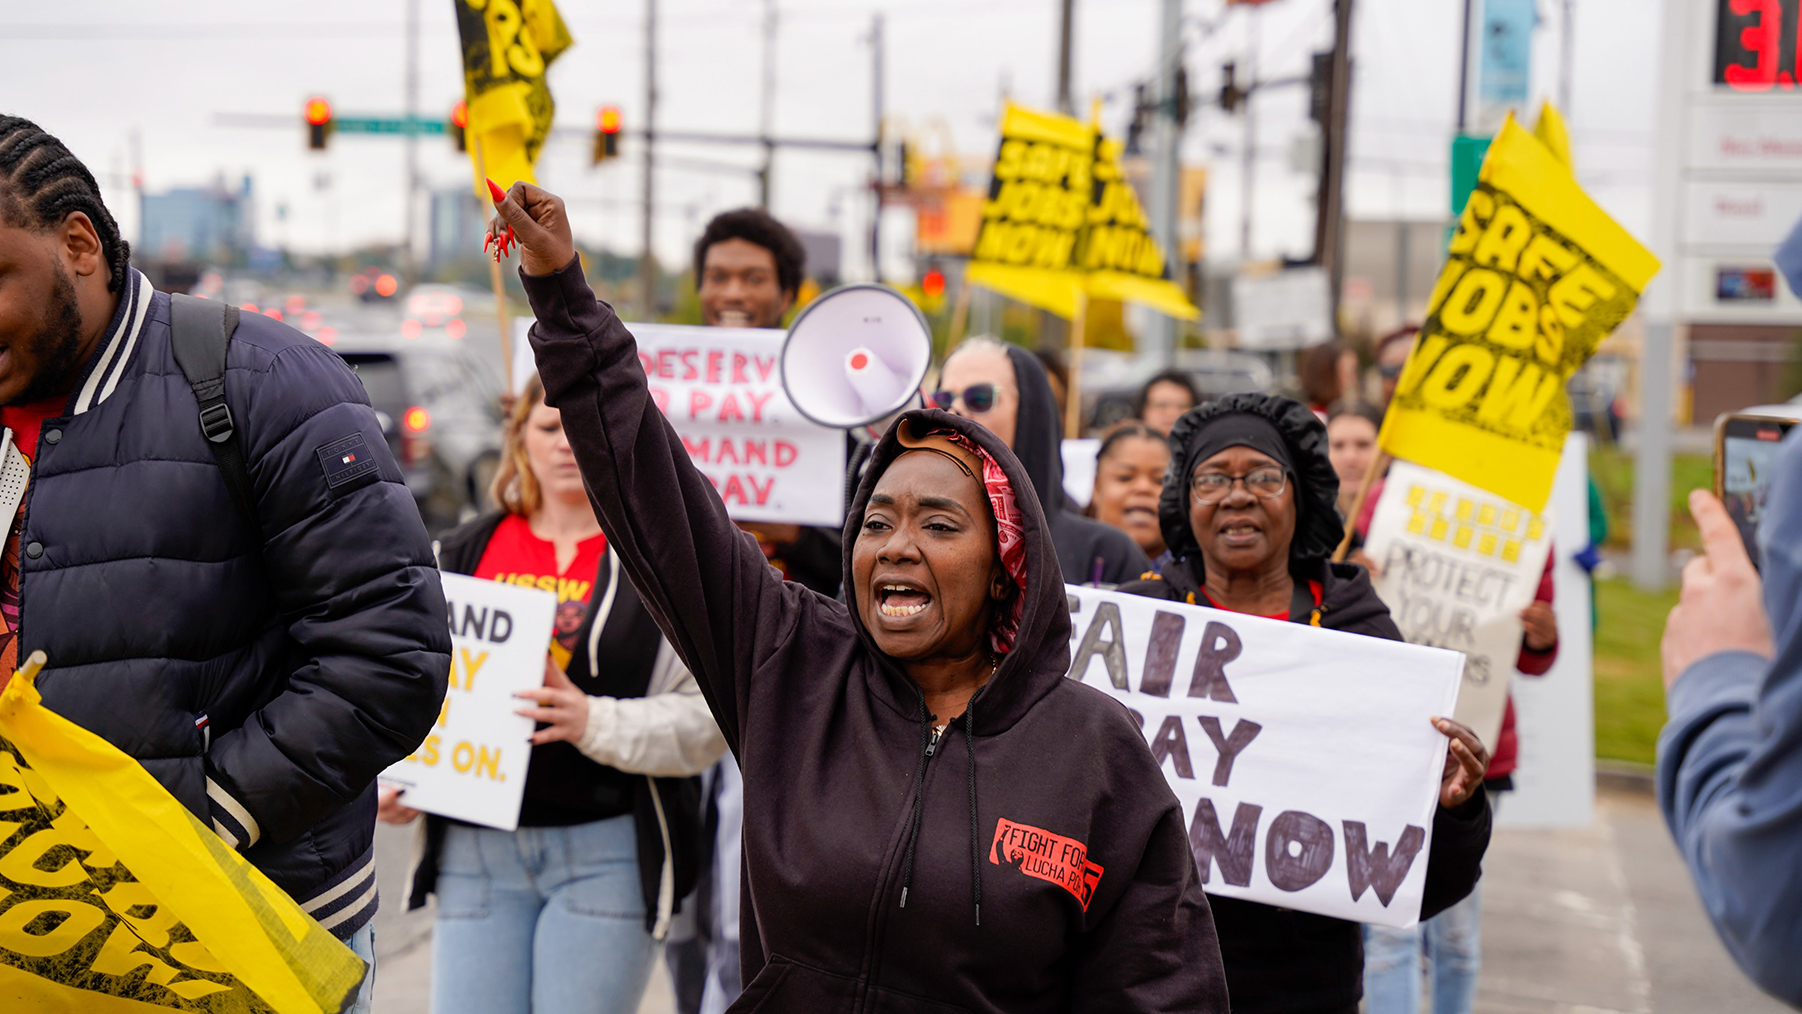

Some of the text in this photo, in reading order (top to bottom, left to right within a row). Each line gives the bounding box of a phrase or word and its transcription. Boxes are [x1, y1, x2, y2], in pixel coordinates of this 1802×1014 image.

[1724, 0, 1802, 92] 3.
[976, 220, 1076, 268] NOW
[1449, 188, 1618, 330] SAFE
[1382, 538, 1521, 612] PROTECT
[1397, 588, 1477, 646] YOUR
[452, 741, 506, 782] ON.
[1128, 706, 1263, 788] AY
[1009, 827, 1058, 860] FIGHT
[1025, 855, 1065, 884] LUCHA
[1188, 797, 1426, 908] NOW
